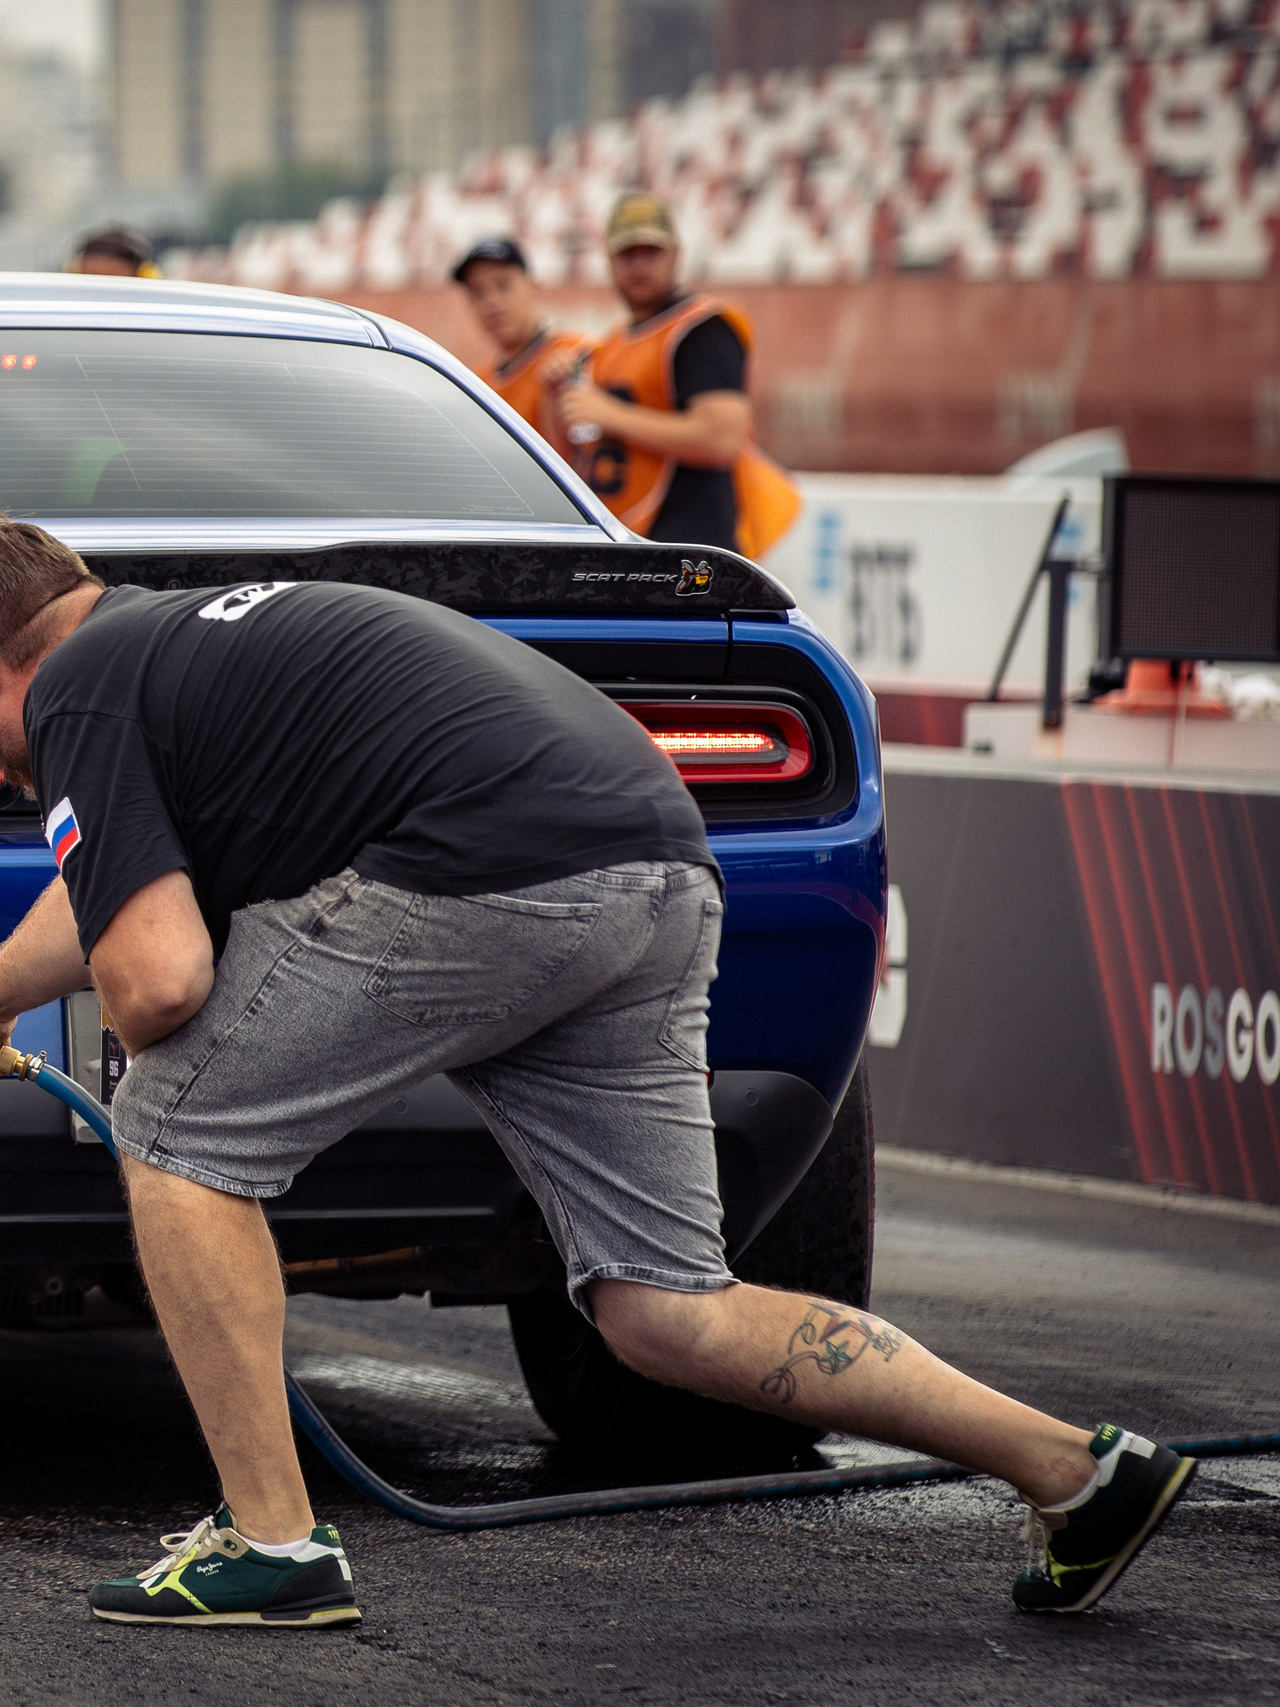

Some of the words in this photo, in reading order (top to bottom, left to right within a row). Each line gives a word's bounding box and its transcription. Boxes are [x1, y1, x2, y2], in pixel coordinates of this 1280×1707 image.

[572, 573, 625, 582] SCAT
[626, 573, 678, 583] PACK
[1150, 981, 1280, 1086] ROSGO
